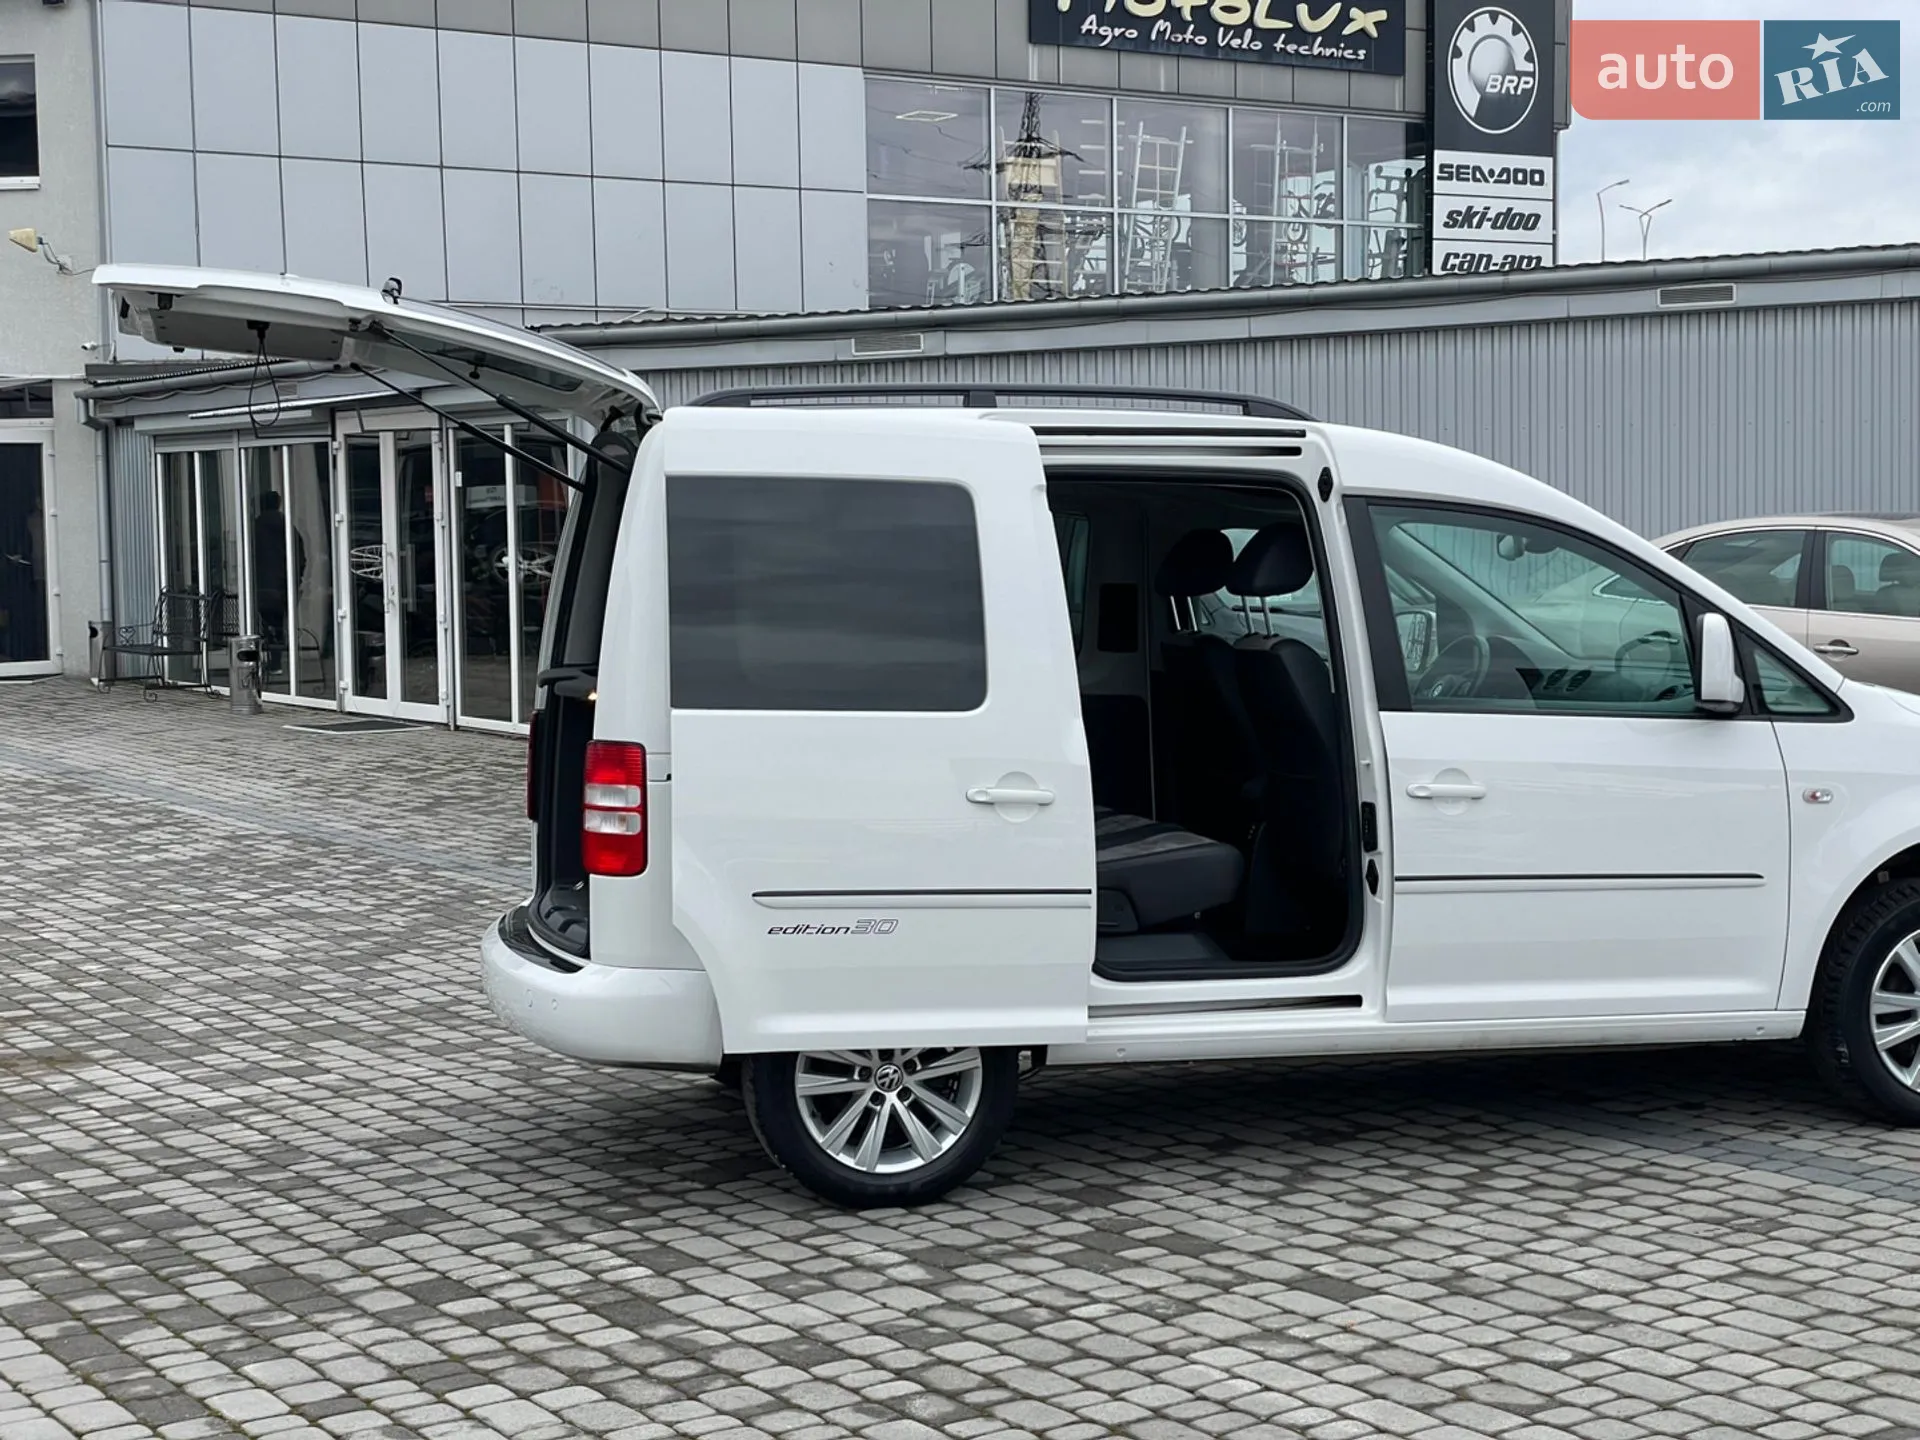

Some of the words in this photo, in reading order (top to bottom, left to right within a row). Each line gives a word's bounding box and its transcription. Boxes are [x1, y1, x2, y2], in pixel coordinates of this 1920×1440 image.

[1080, 13, 1139, 47] Agro
[1150, 19, 1208, 46] Moto
[1217, 26, 1263, 50] Velo
[1273, 33, 1367, 60] technics
[1485, 74, 1534, 95] BRP
[1442, 205, 1542, 231] ski-doo
[1441, 252, 1542, 273] can-am
